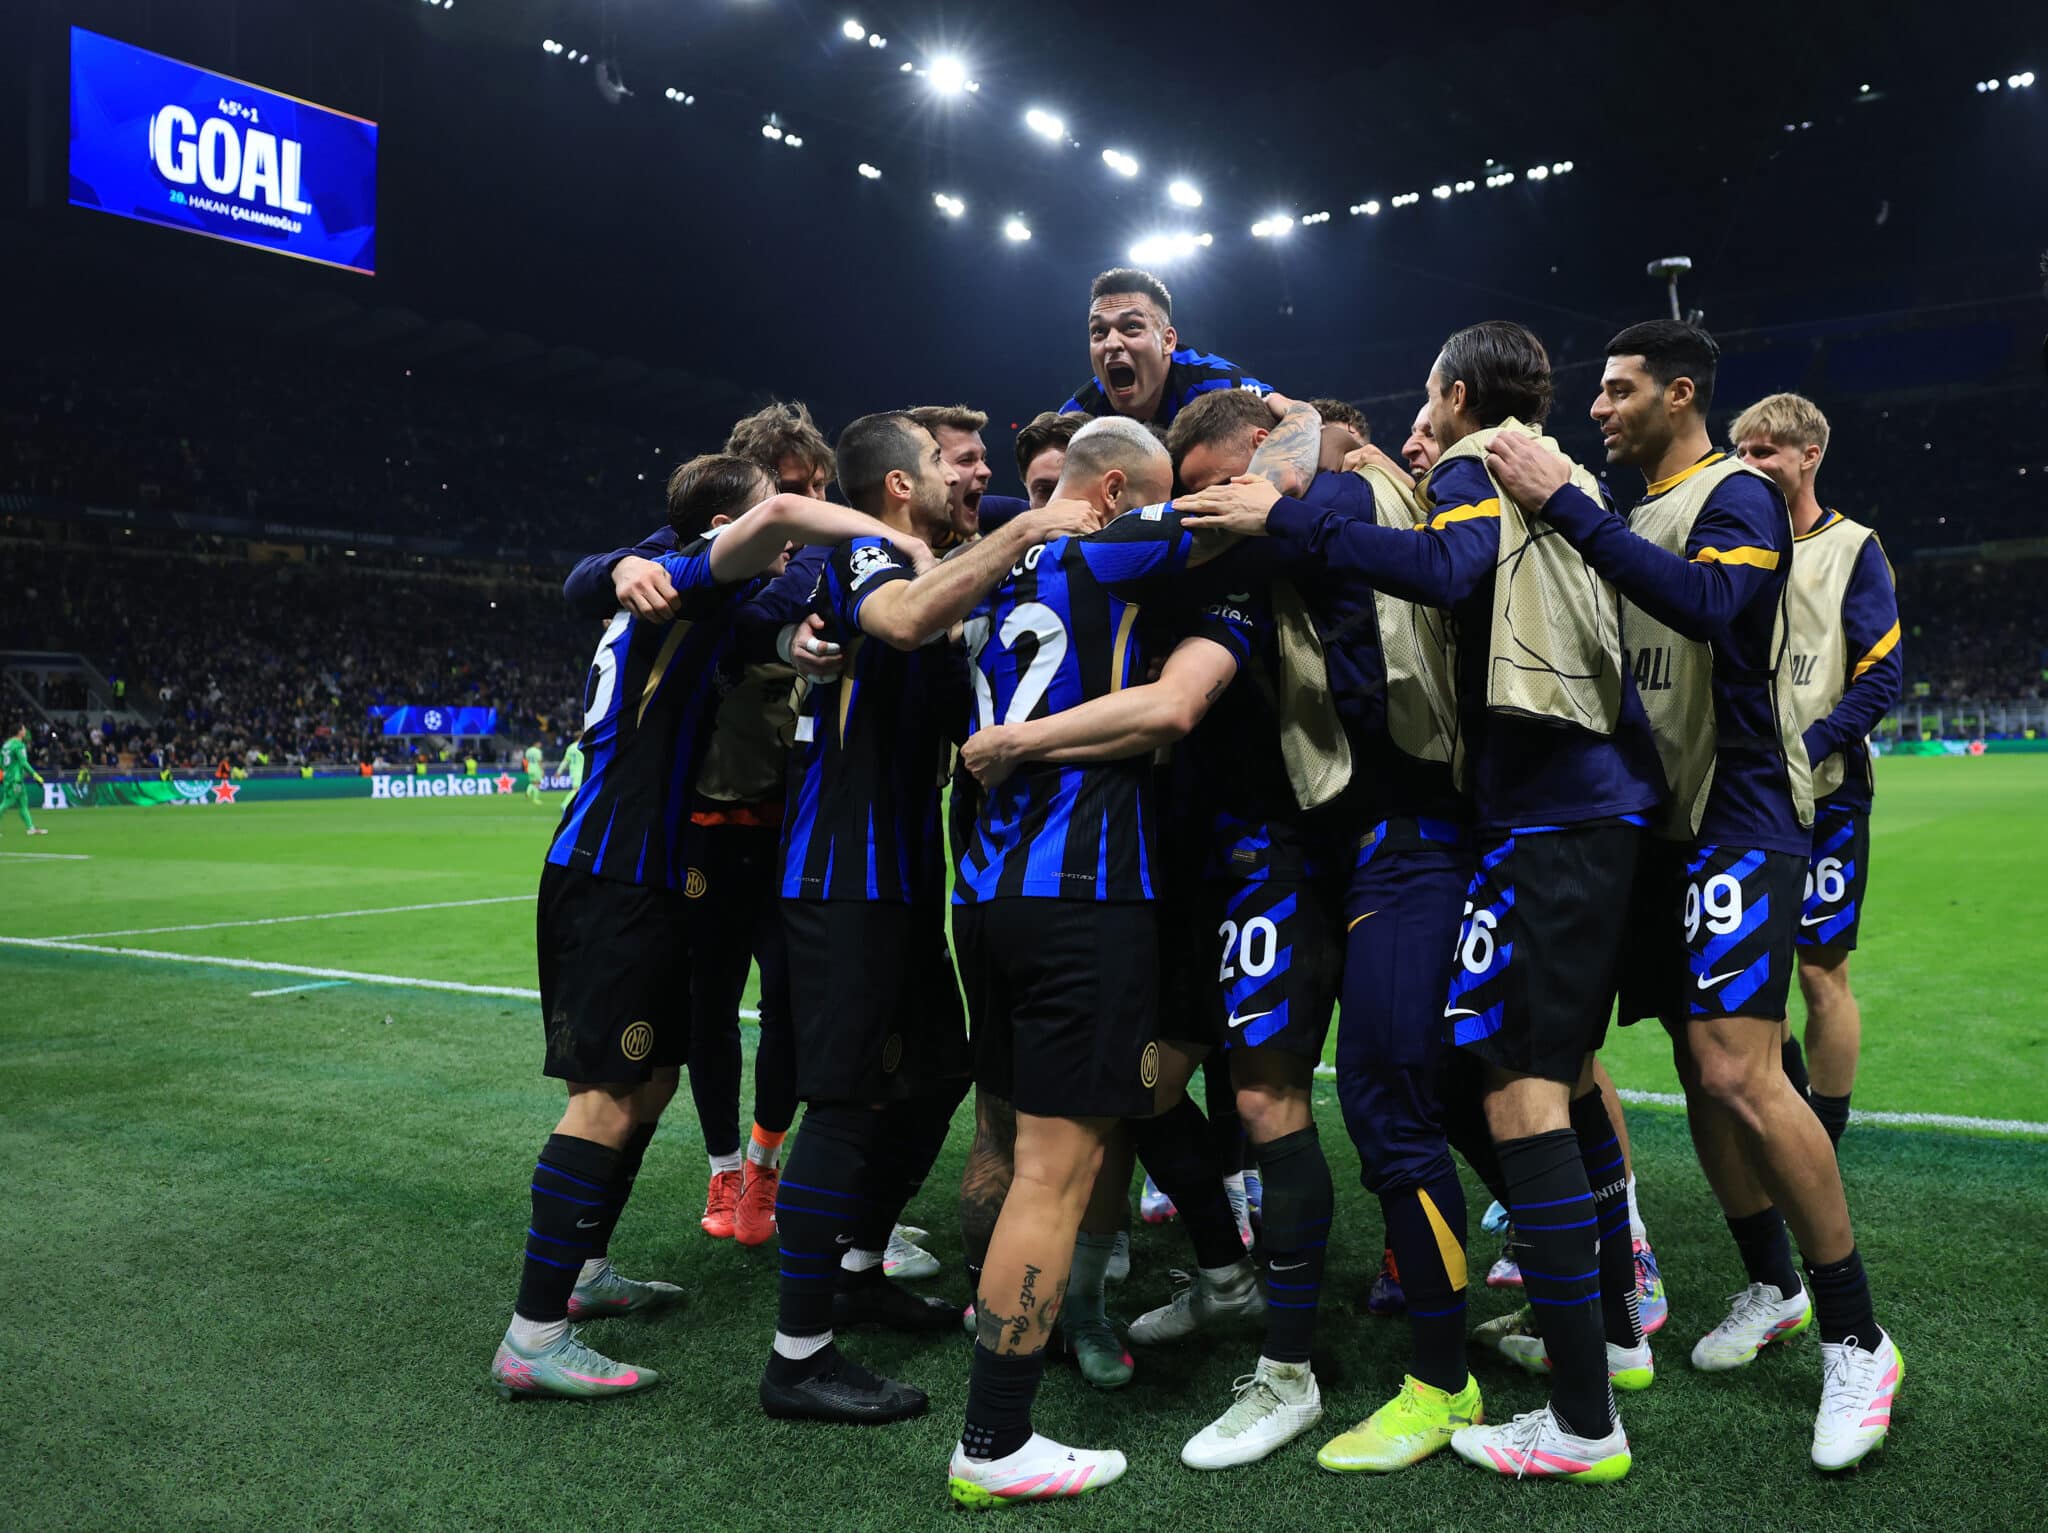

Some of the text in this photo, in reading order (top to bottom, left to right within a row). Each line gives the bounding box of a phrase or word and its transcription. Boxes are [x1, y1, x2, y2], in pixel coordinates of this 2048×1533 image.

[218, 98, 259, 123] 45'+1
[150, 104, 312, 216] GOAL
[189, 194, 230, 216] HAKAN
[1633, 645, 1673, 691] ALL
[371, 774, 493, 798] Heineken
[550, 775, 572, 789] UEF
[1684, 873, 1743, 944] 99
[1218, 915, 1278, 983] 20
[1592, 1177, 1628, 1204] INTER
